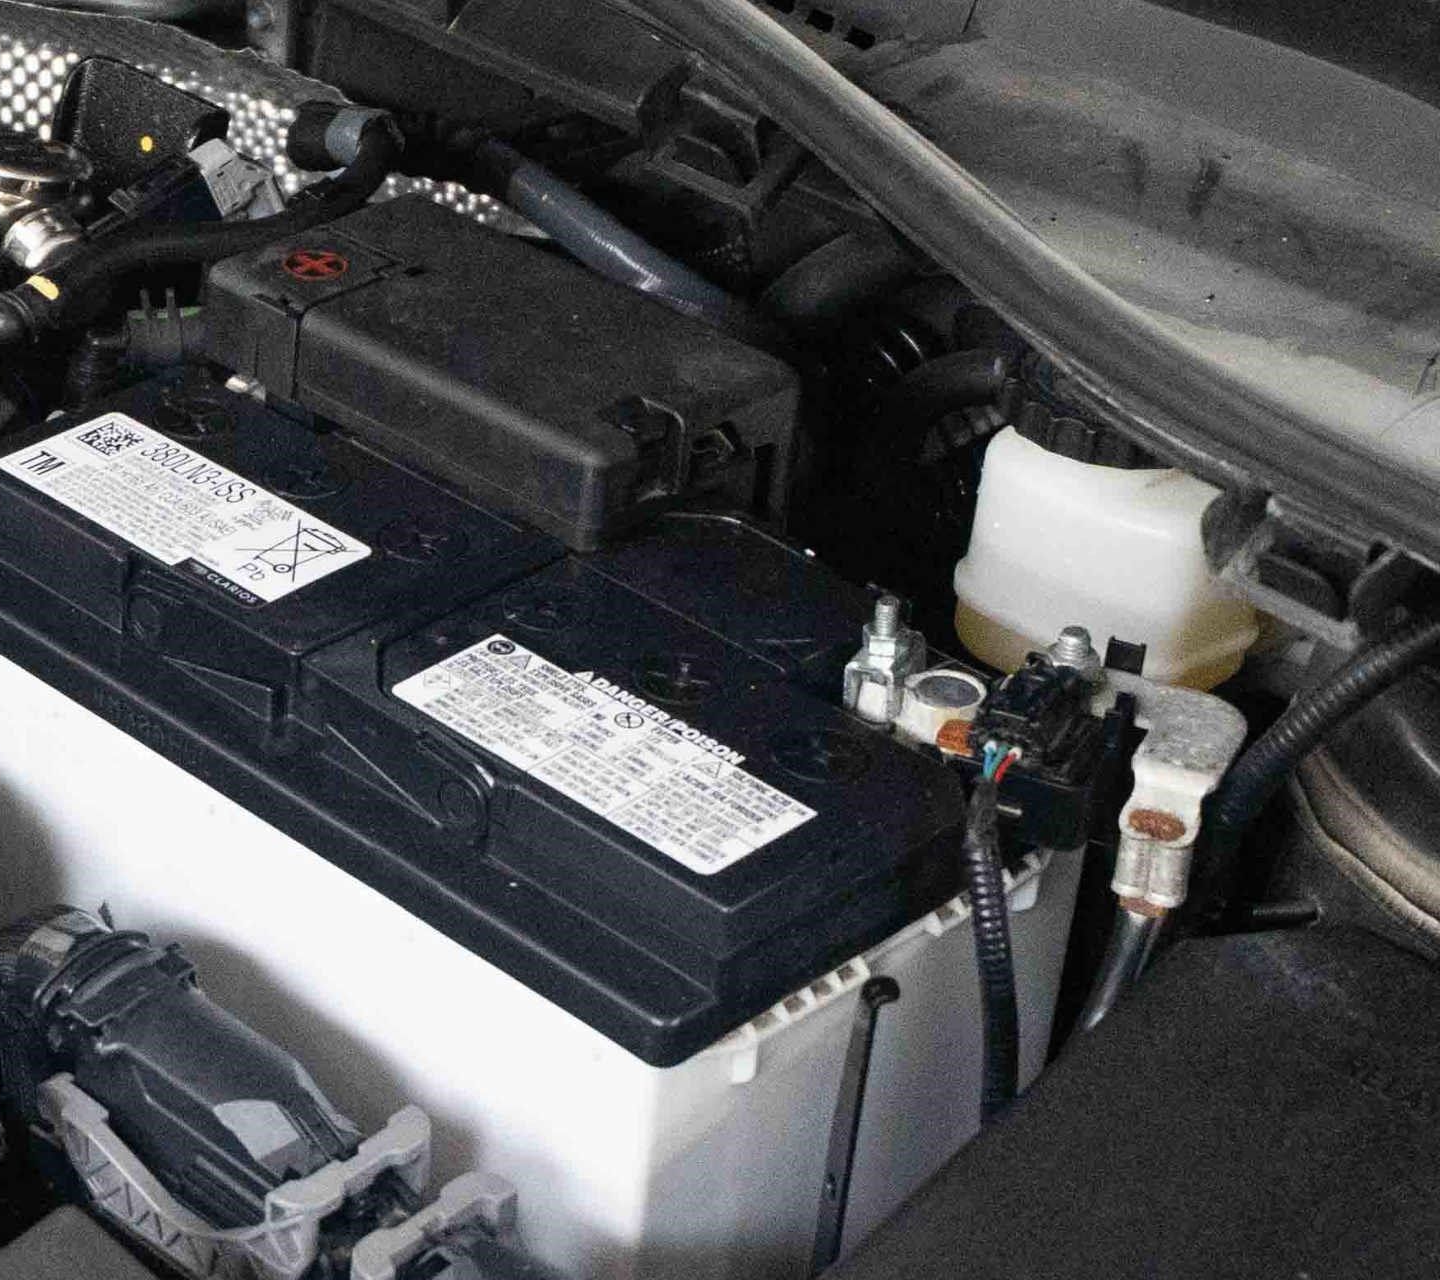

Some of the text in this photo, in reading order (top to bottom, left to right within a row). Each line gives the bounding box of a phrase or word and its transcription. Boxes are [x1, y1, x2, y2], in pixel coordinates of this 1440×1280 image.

[19, 449, 66, 477] TM
[139, 441, 257, 504] 380LN3-ISS
[206, 572, 258, 605] CLARIOS
[237, 562, 267, 582] Pb
[590, 677, 746, 767] DANGER/POISON
